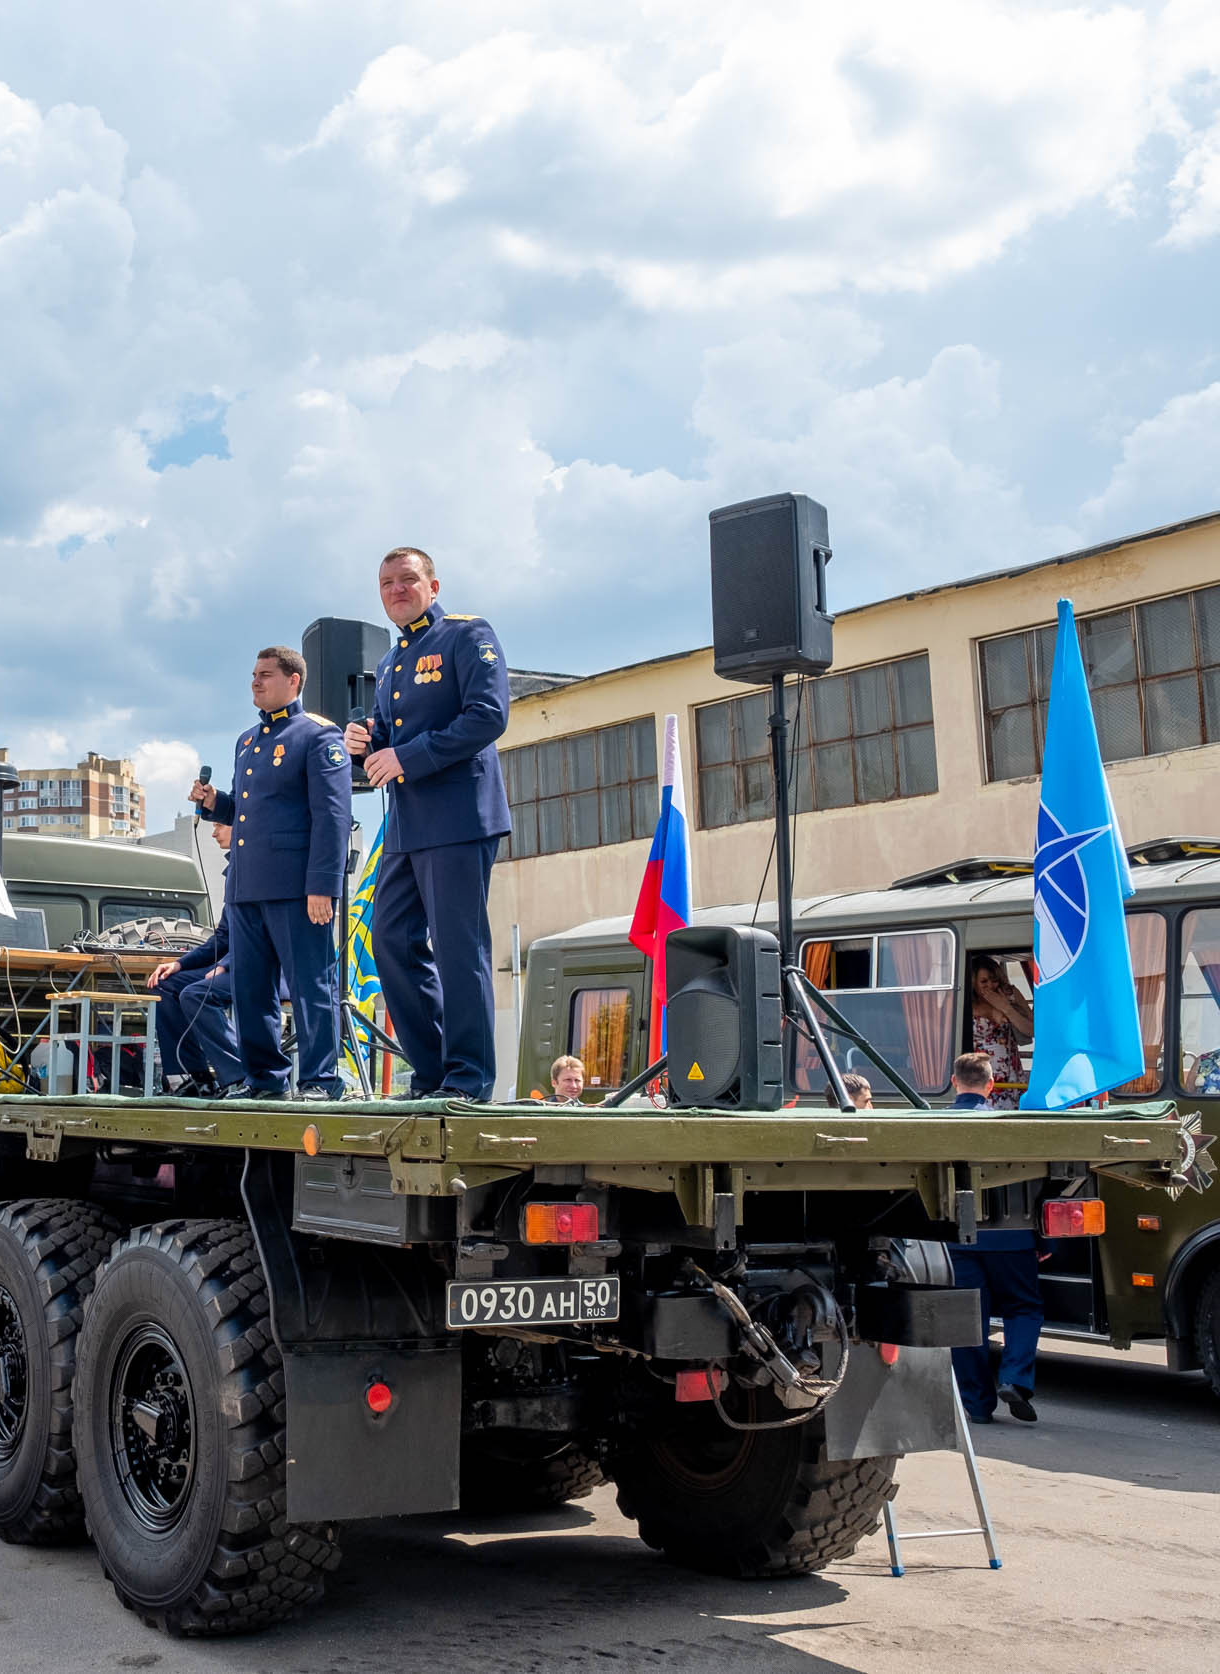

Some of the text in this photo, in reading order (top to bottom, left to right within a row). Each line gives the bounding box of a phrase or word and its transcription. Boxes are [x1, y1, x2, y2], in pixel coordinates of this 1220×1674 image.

[460, 1286, 575, 1321] 0930 АН
[583, 1281, 611, 1307] 50
[586, 1307, 606, 1317] RUS
